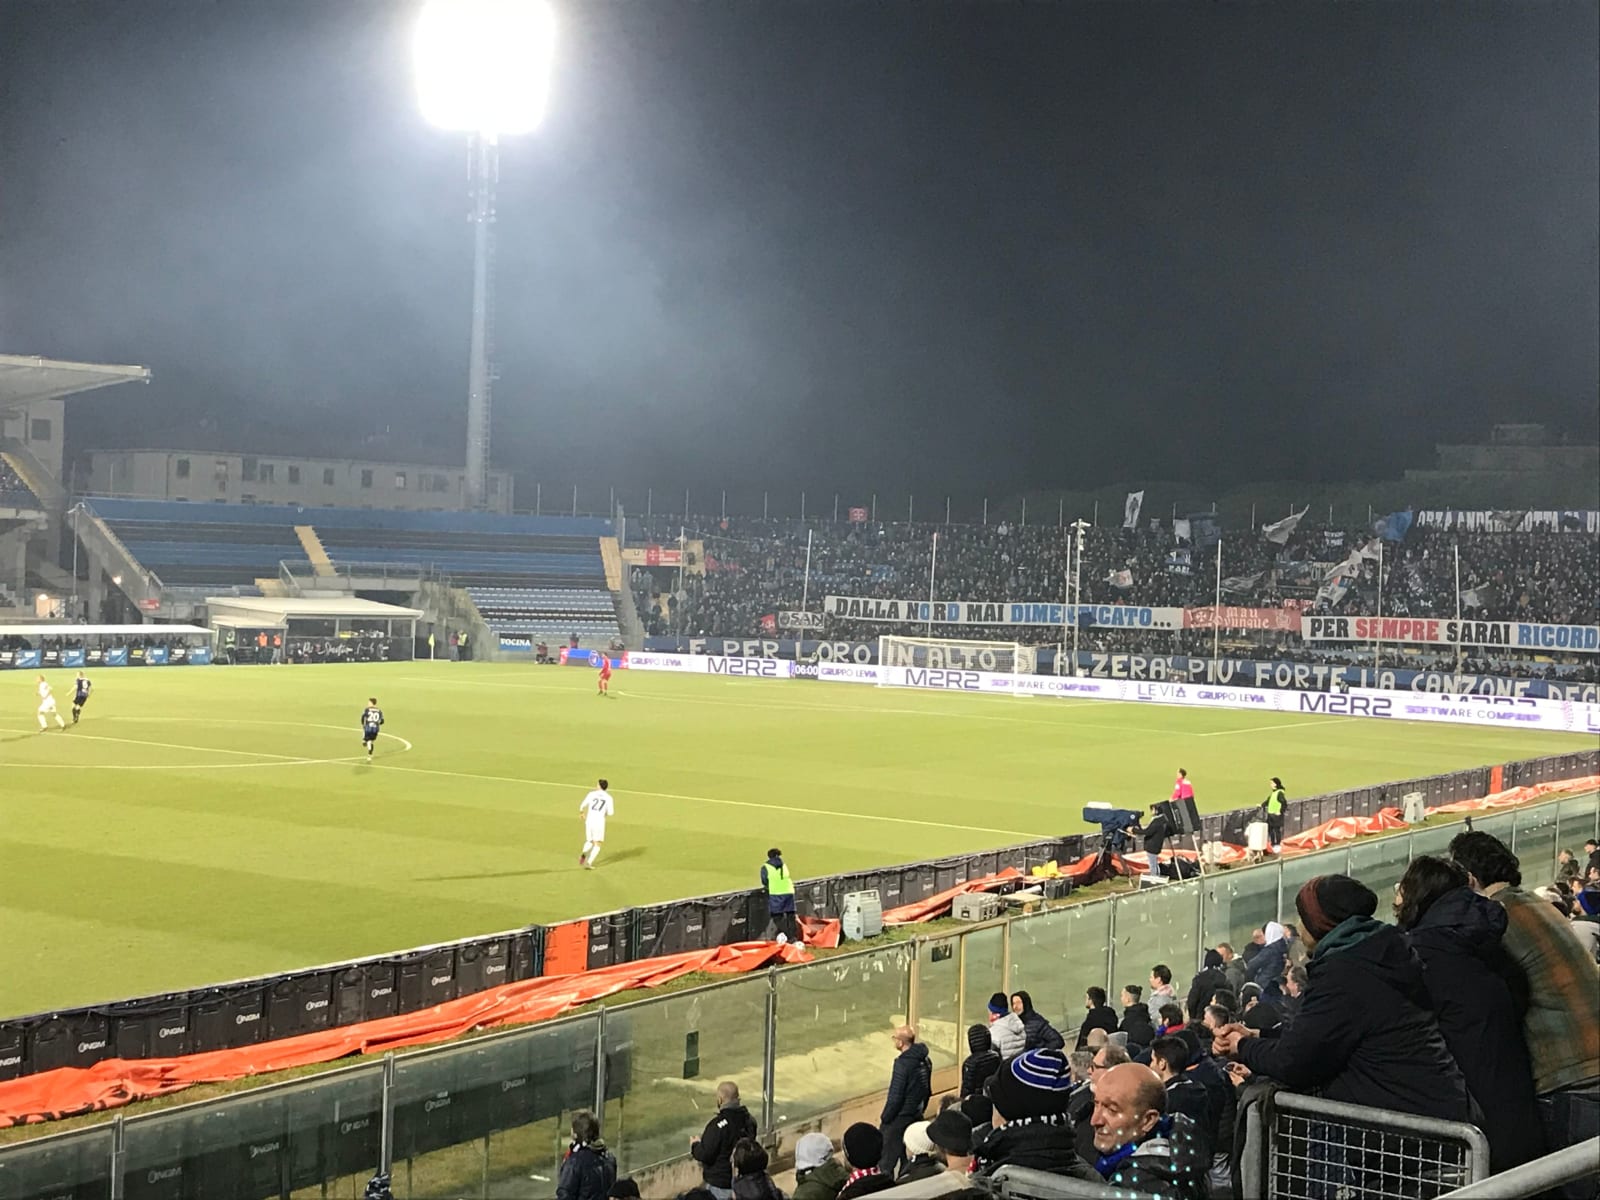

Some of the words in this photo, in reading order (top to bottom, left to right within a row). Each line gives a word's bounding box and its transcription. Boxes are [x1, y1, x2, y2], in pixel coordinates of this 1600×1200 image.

[835, 598, 900, 620] DALLA
[906, 602, 960, 622] NORD
[967, 604, 1004, 622] MAI
[1310, 618, 1349, 638] PER
[1355, 619, 1439, 641] SEMPRE
[1447, 622, 1510, 644] SARAI
[1518, 624, 1600, 649] RICORD
[707, 657, 777, 676] M2R2
[723, 640, 779, 659] PER
[795, 641, 871, 664] LORO
[928, 647, 996, 670] ALTO
[1255, 662, 1347, 690] FORTE
[1411, 673, 1530, 698] CANZONE
[795, 665, 818, 676] 06:00
[906, 669, 980, 689] M2R2
[1197, 690, 1237, 701] GRUPPO
[1239, 694, 1266, 703] LEVIA
[1300, 693, 1392, 716] M2R2
[367, 711, 380, 722] 20
[591, 798, 606, 812] 27
